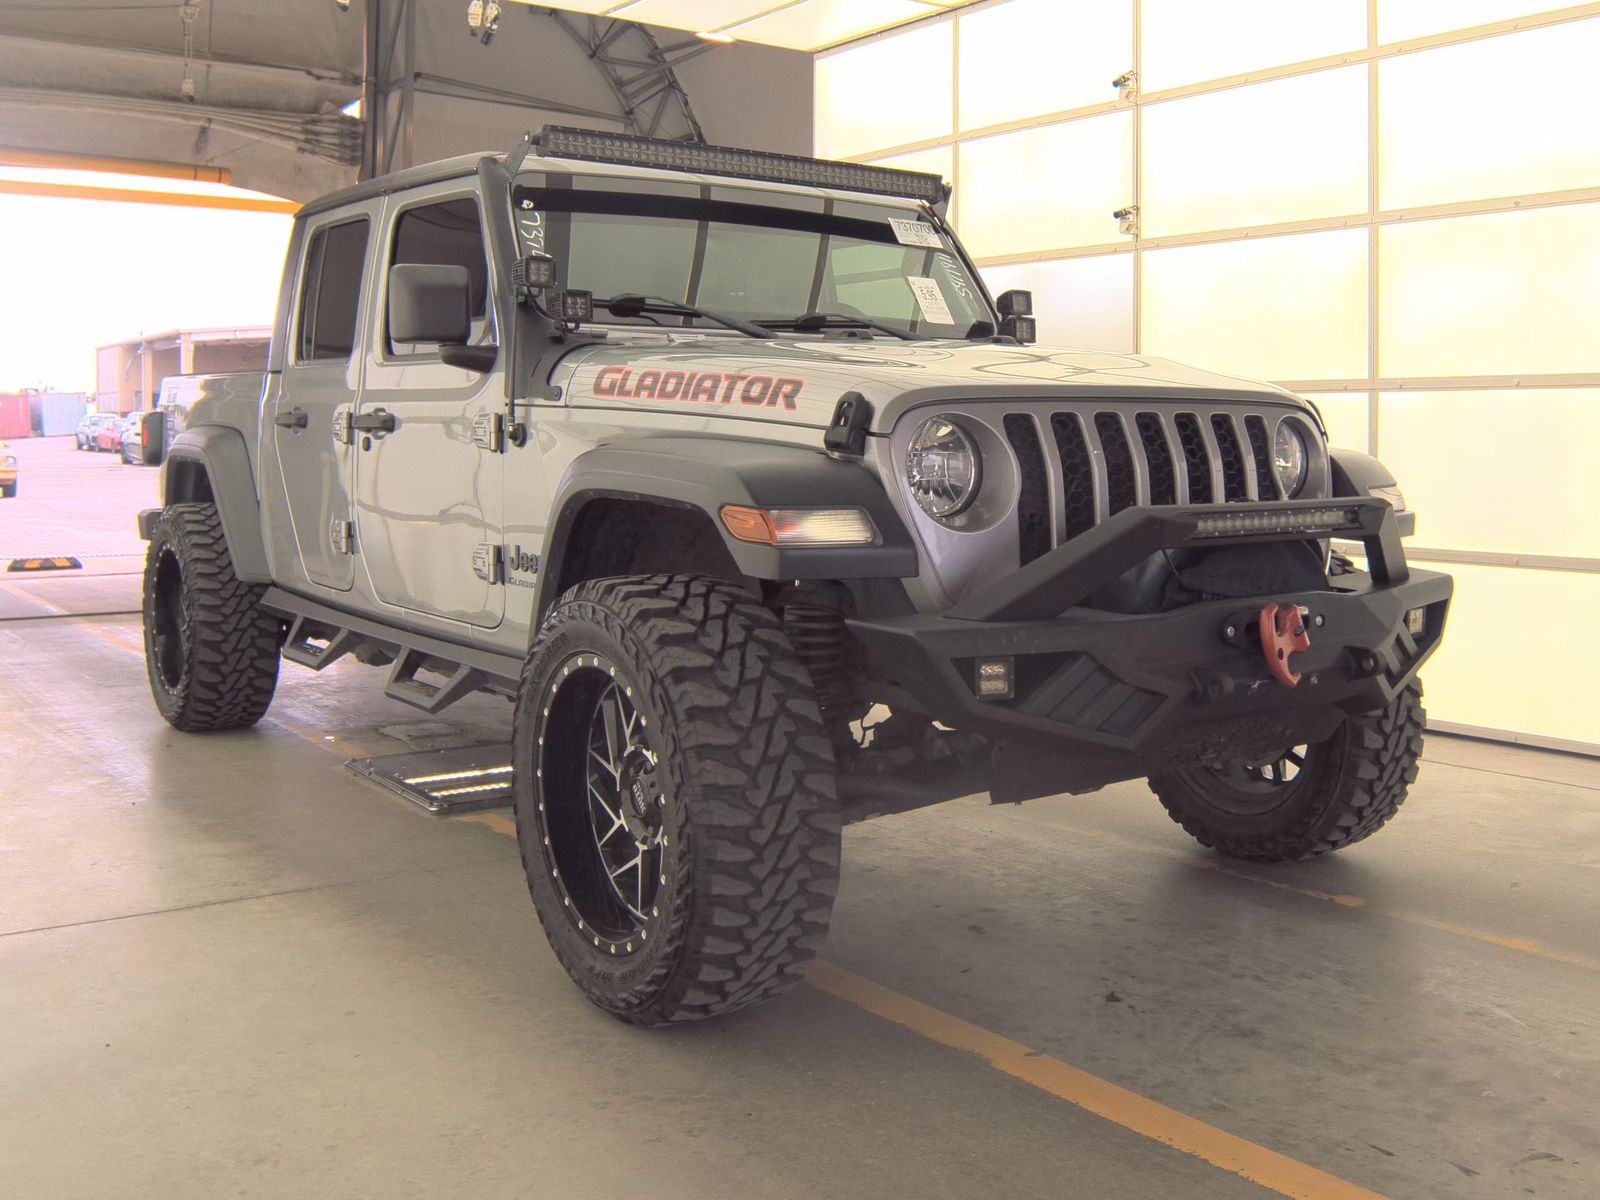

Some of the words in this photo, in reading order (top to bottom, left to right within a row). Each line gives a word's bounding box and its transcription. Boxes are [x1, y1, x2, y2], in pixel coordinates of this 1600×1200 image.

[592, 365, 804, 411] GLADIATOR
[509, 544, 541, 574] Jee
[509, 577, 537, 589] GLADIA
